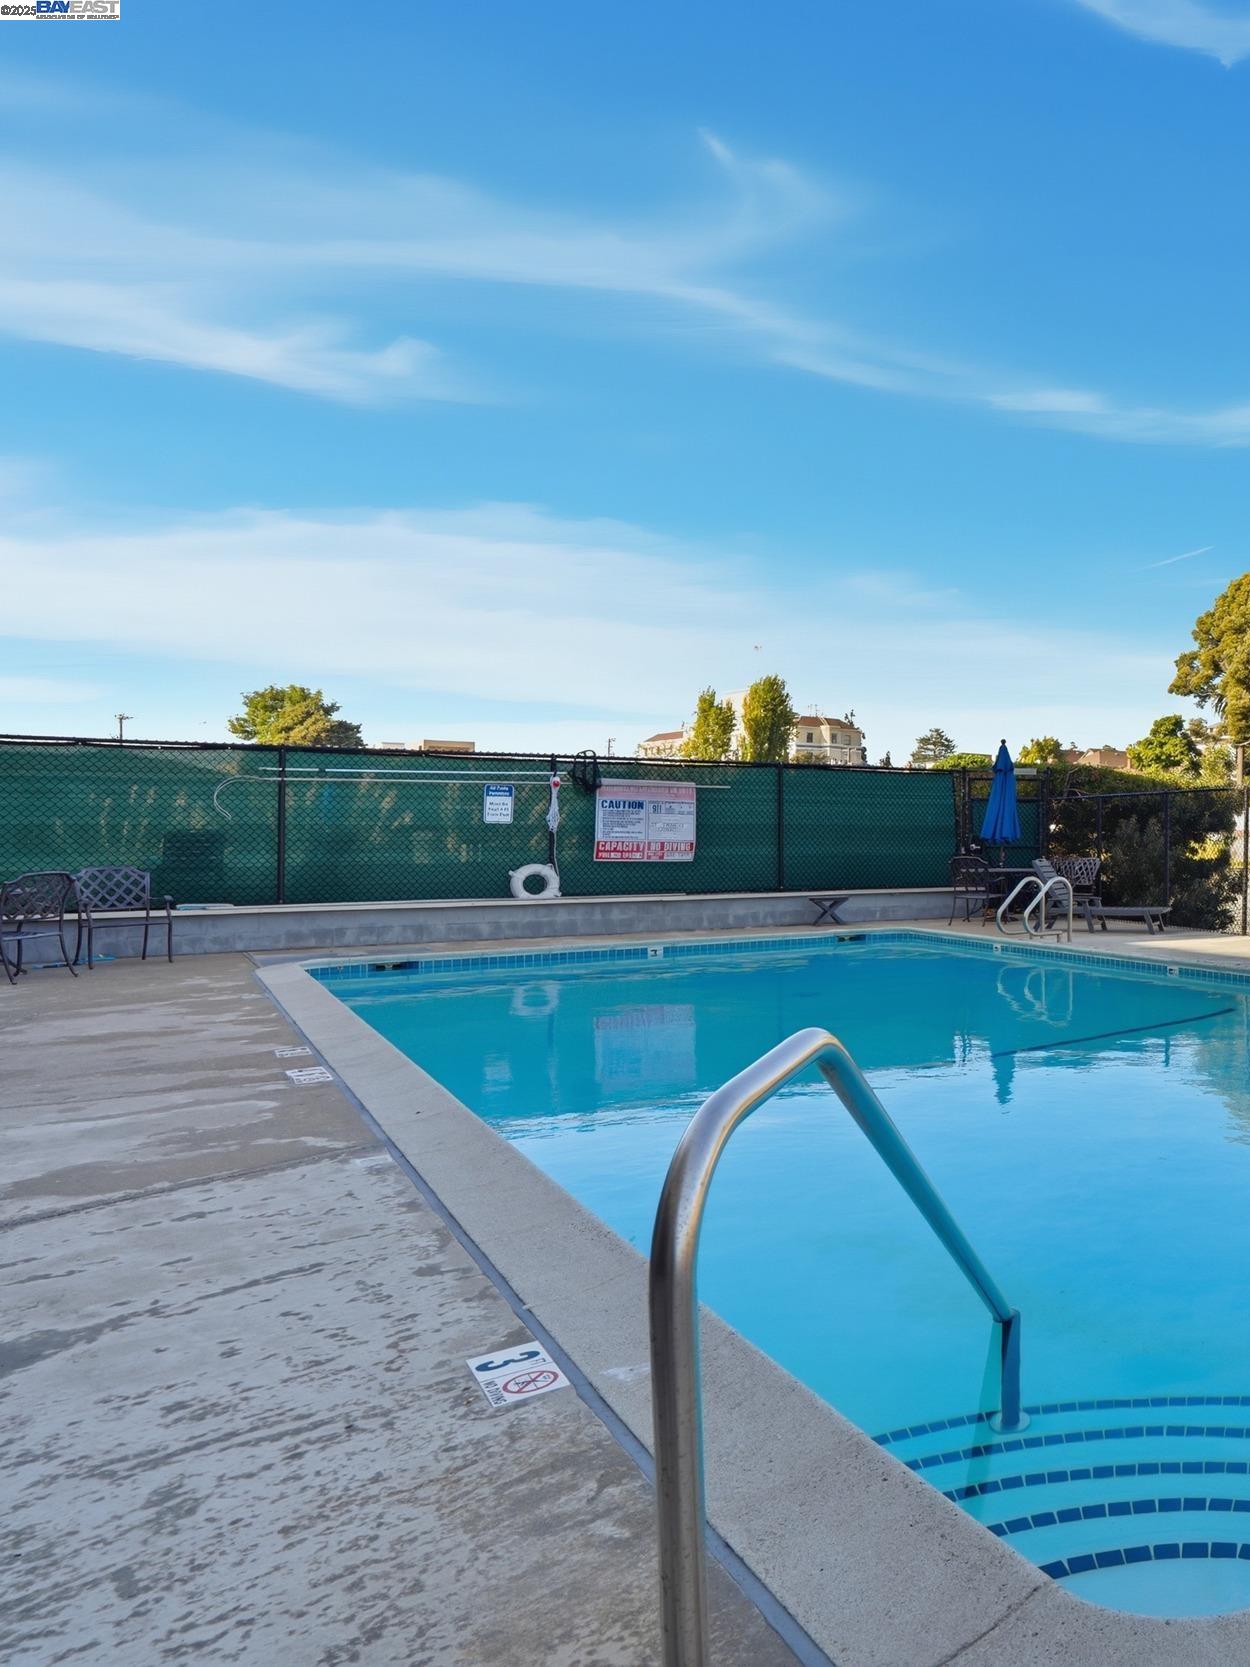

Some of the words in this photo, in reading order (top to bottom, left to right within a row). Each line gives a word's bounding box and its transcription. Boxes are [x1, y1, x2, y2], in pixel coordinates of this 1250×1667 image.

[601, 800, 644, 810] CAUTION
[652, 804, 661, 814] 911
[599, 842, 644, 851] CAPACITY
[651, 842, 662, 851] NO
[664, 842, 691, 851] DIVING
[475, 1350, 540, 1372] 3
